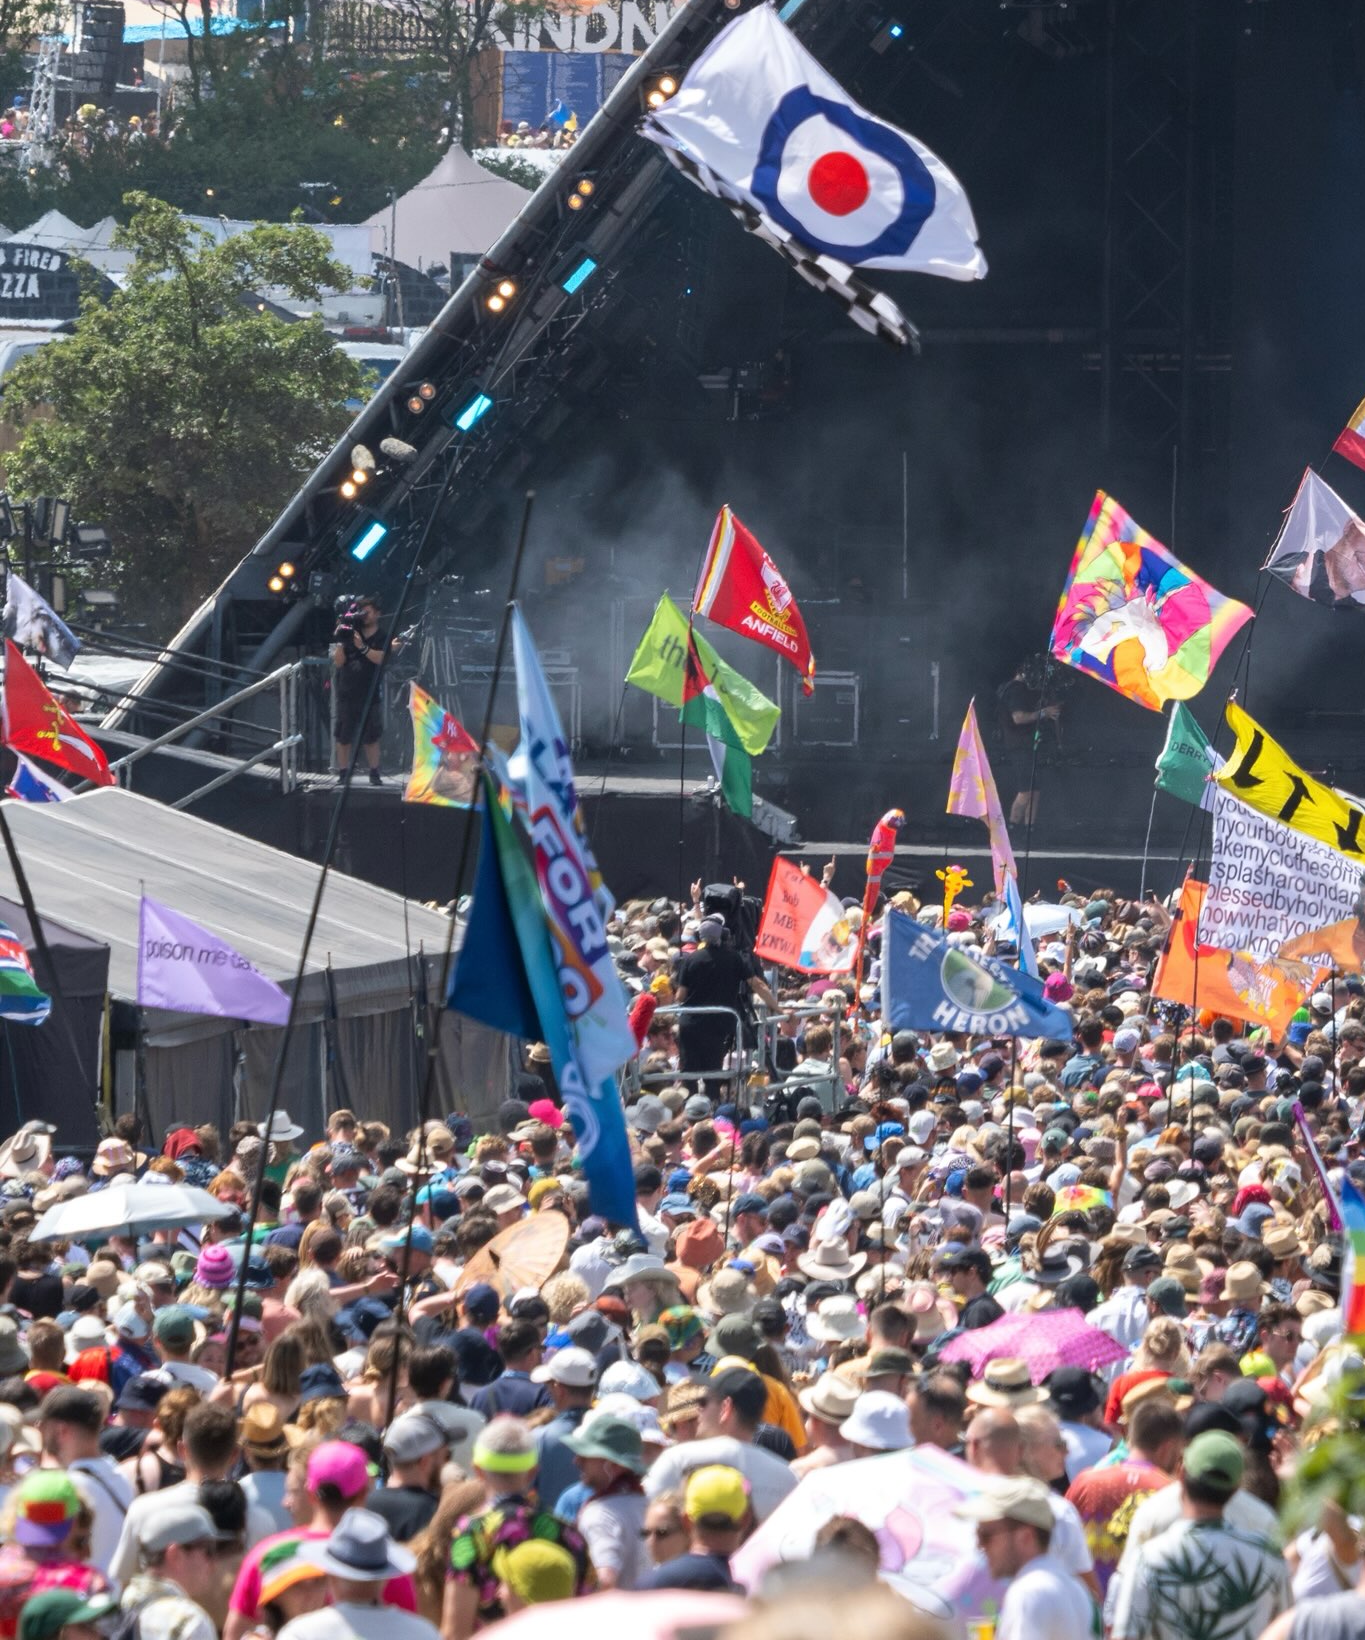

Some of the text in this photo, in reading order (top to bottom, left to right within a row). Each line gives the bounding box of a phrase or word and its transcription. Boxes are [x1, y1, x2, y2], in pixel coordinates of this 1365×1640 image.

[14, 248, 61, 272] FIRED
[741, 614, 799, 654] ANFIELD
[531, 815, 607, 957] FOR
[932, 1000, 1031, 1036] HERON
